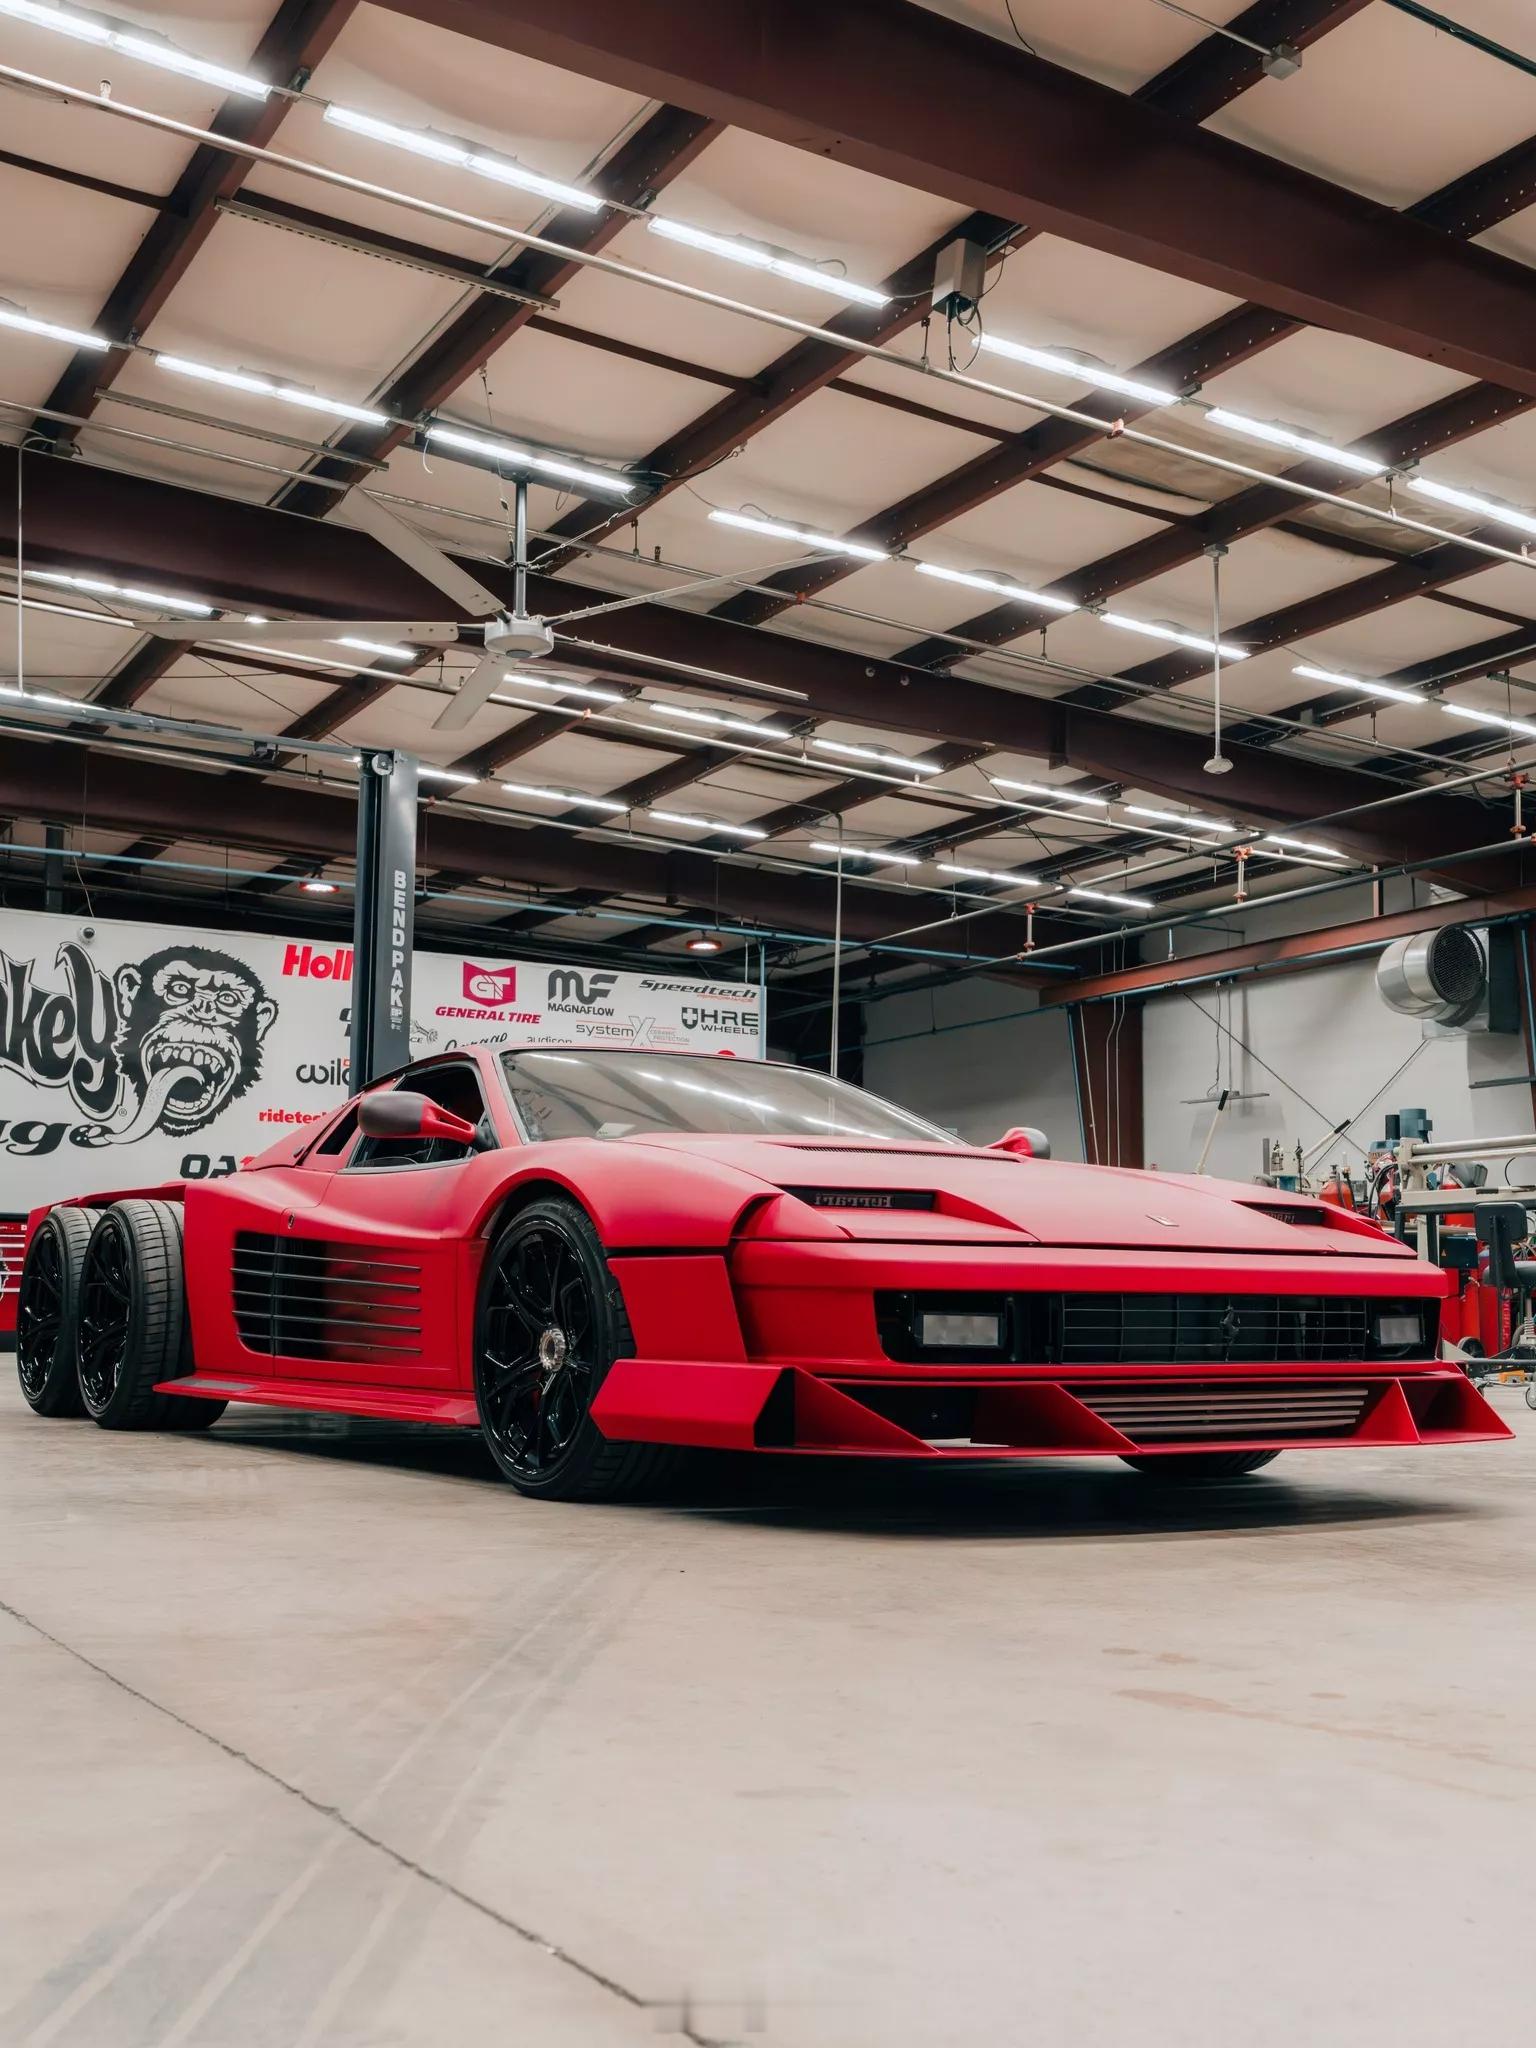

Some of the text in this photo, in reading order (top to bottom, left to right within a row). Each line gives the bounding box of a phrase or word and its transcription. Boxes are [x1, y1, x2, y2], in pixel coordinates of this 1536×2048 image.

[640, 979, 757, 998] Speedtech
[435, 1006, 541, 1024] GENERAL TIRE
[547, 1003, 614, 1016] MAGNAFLOW
[701, 1009, 758, 1027] HRE
[701, 1024, 758, 1036] WHEELS
